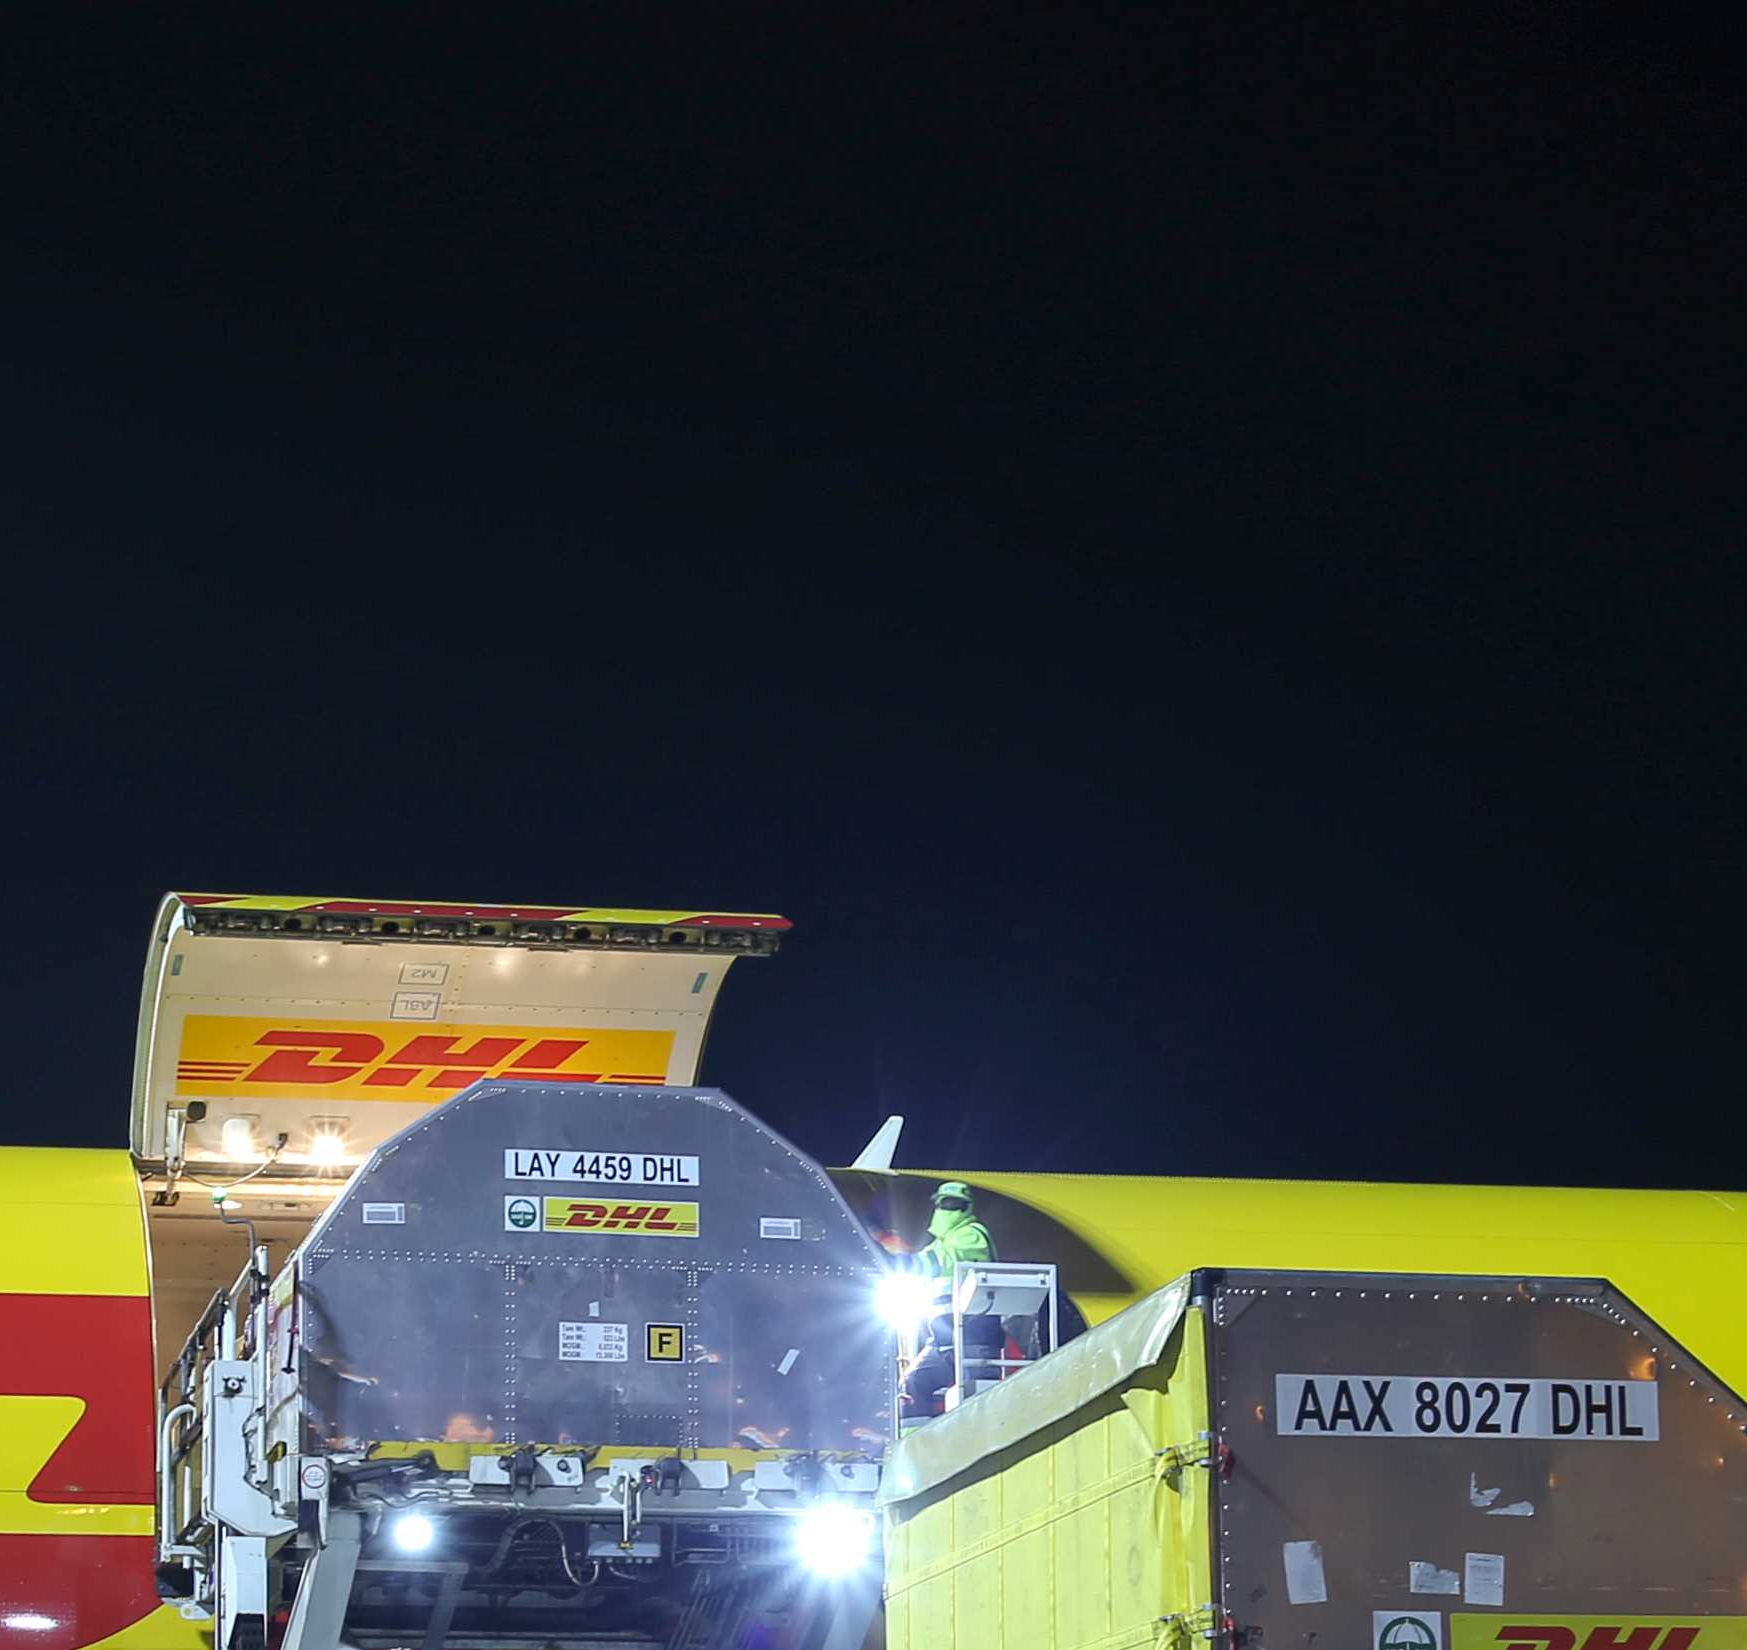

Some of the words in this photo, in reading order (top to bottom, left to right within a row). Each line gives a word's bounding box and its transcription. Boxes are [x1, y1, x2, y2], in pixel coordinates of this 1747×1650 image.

[242, 1030, 602, 1088] DHL
[514, 1151, 561, 1177] LAY
[572, 1154, 632, 1181] 4459
[643, 1157, 690, 1183] DHL
[565, 1203, 679, 1230] DHL
[658, 1332, 673, 1353] F
[1293, 1379, 1393, 1432] AAX
[1414, 1380, 1530, 1435] 8027
[1551, 1383, 1645, 1438] DHL
